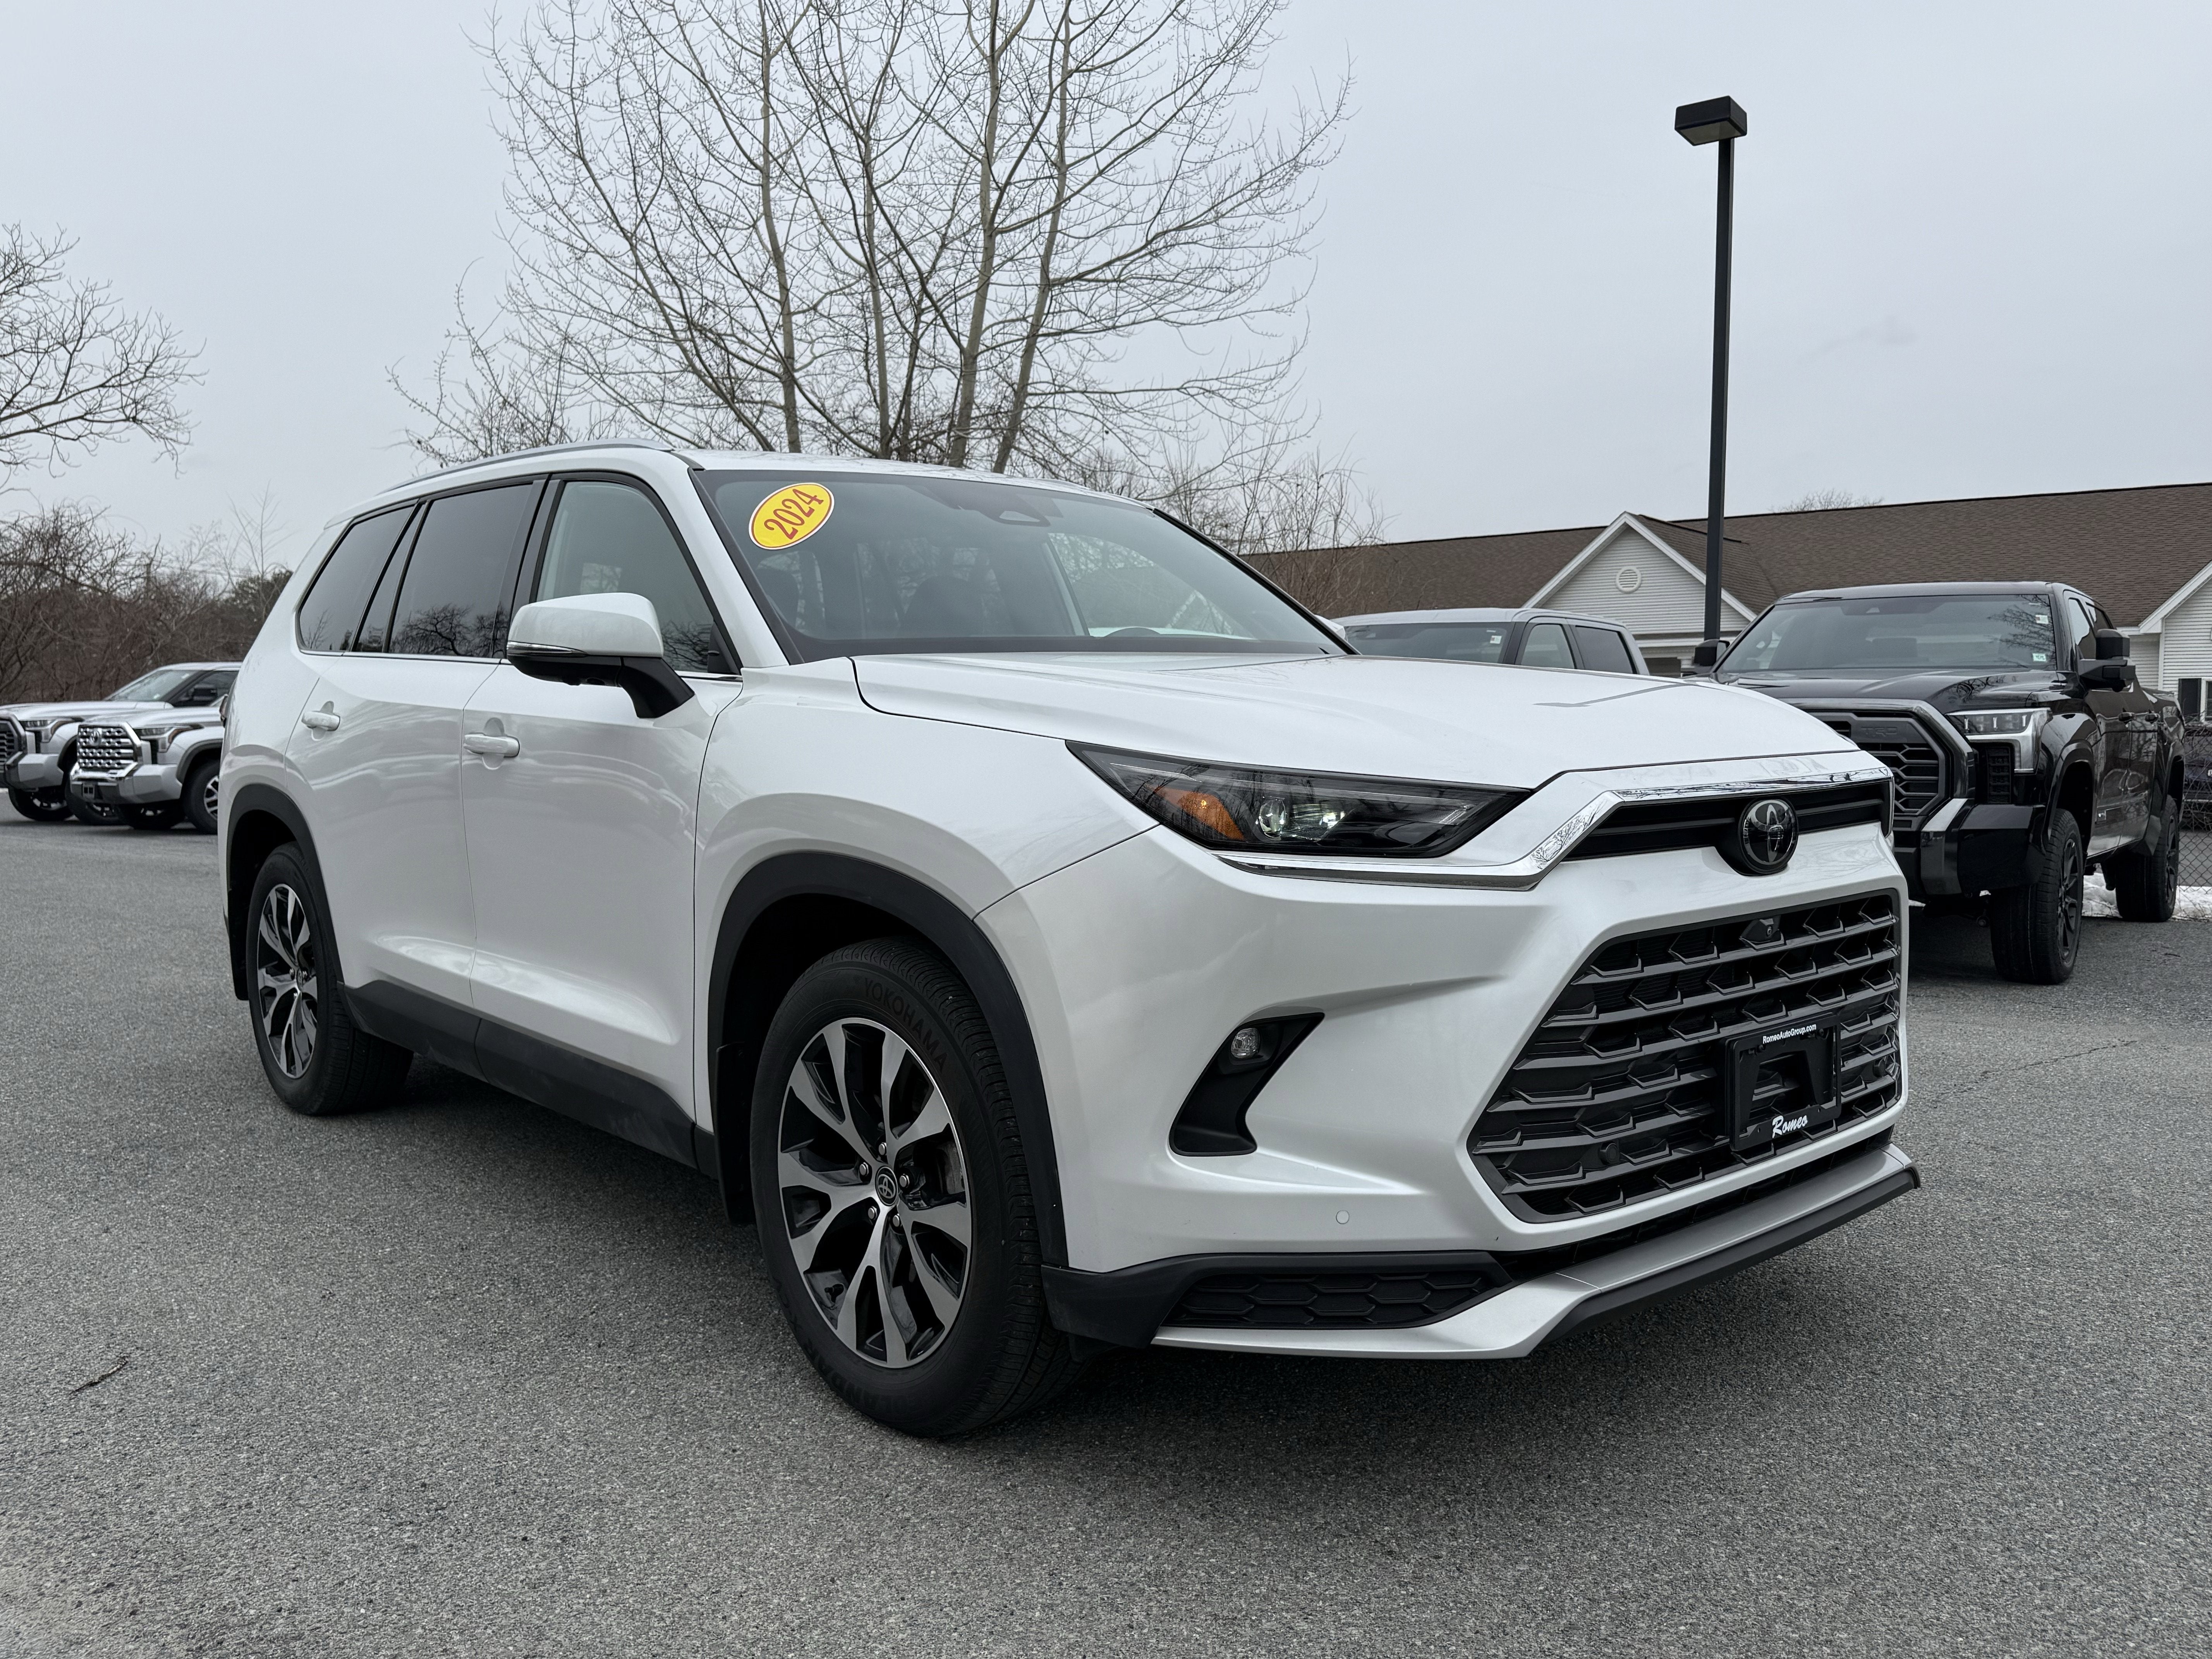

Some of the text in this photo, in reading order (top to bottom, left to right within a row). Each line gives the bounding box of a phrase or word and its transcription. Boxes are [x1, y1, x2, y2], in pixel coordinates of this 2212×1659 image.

[764, 489, 824, 539] 2024
[865, 977, 948, 1072] YOKOHAMA
[1762, 1024, 1817, 1044] RomeoAutoGroup.com
[1772, 1115, 1808, 1139] Romeo
